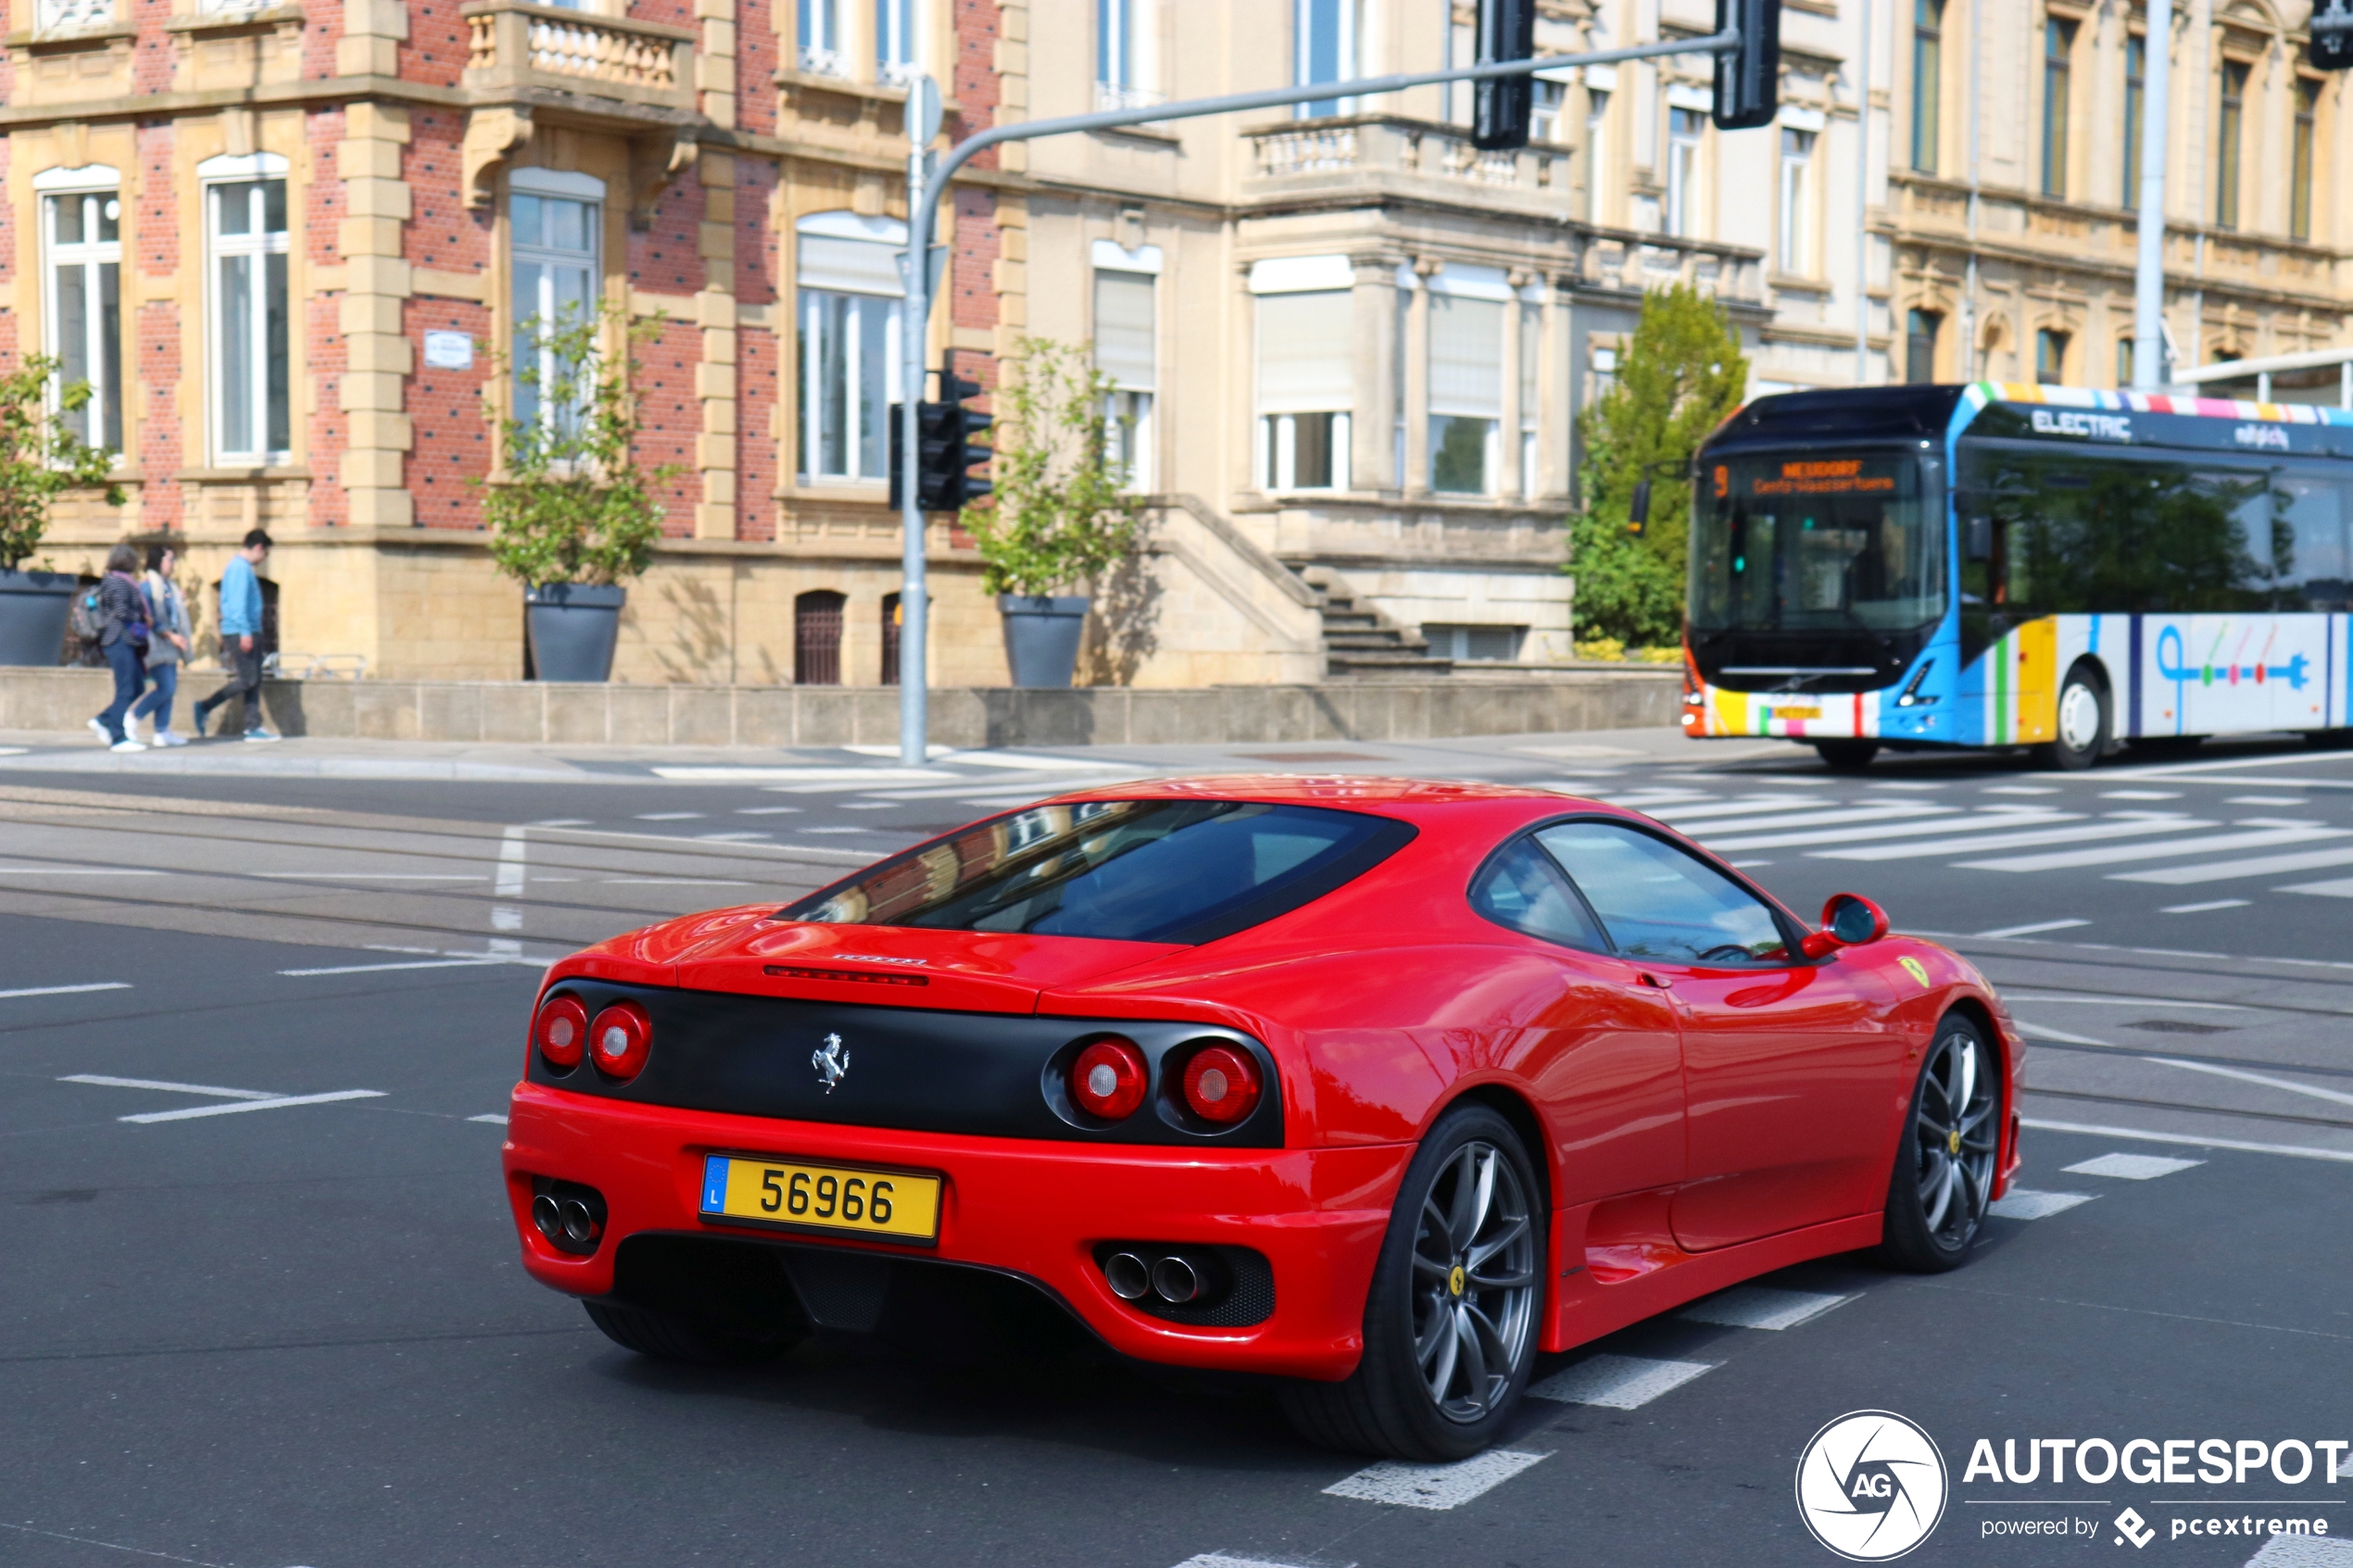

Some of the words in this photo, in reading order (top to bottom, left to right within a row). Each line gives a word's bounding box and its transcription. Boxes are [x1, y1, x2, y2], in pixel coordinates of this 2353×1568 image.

[2032, 409, 2132, 439] ELECTRIC
[1714, 465, 1729, 497] 9
[1781, 459, 1863, 479] NEUDORF
[710, 1189, 718, 1204] L
[761, 1169, 894, 1223] 56966
